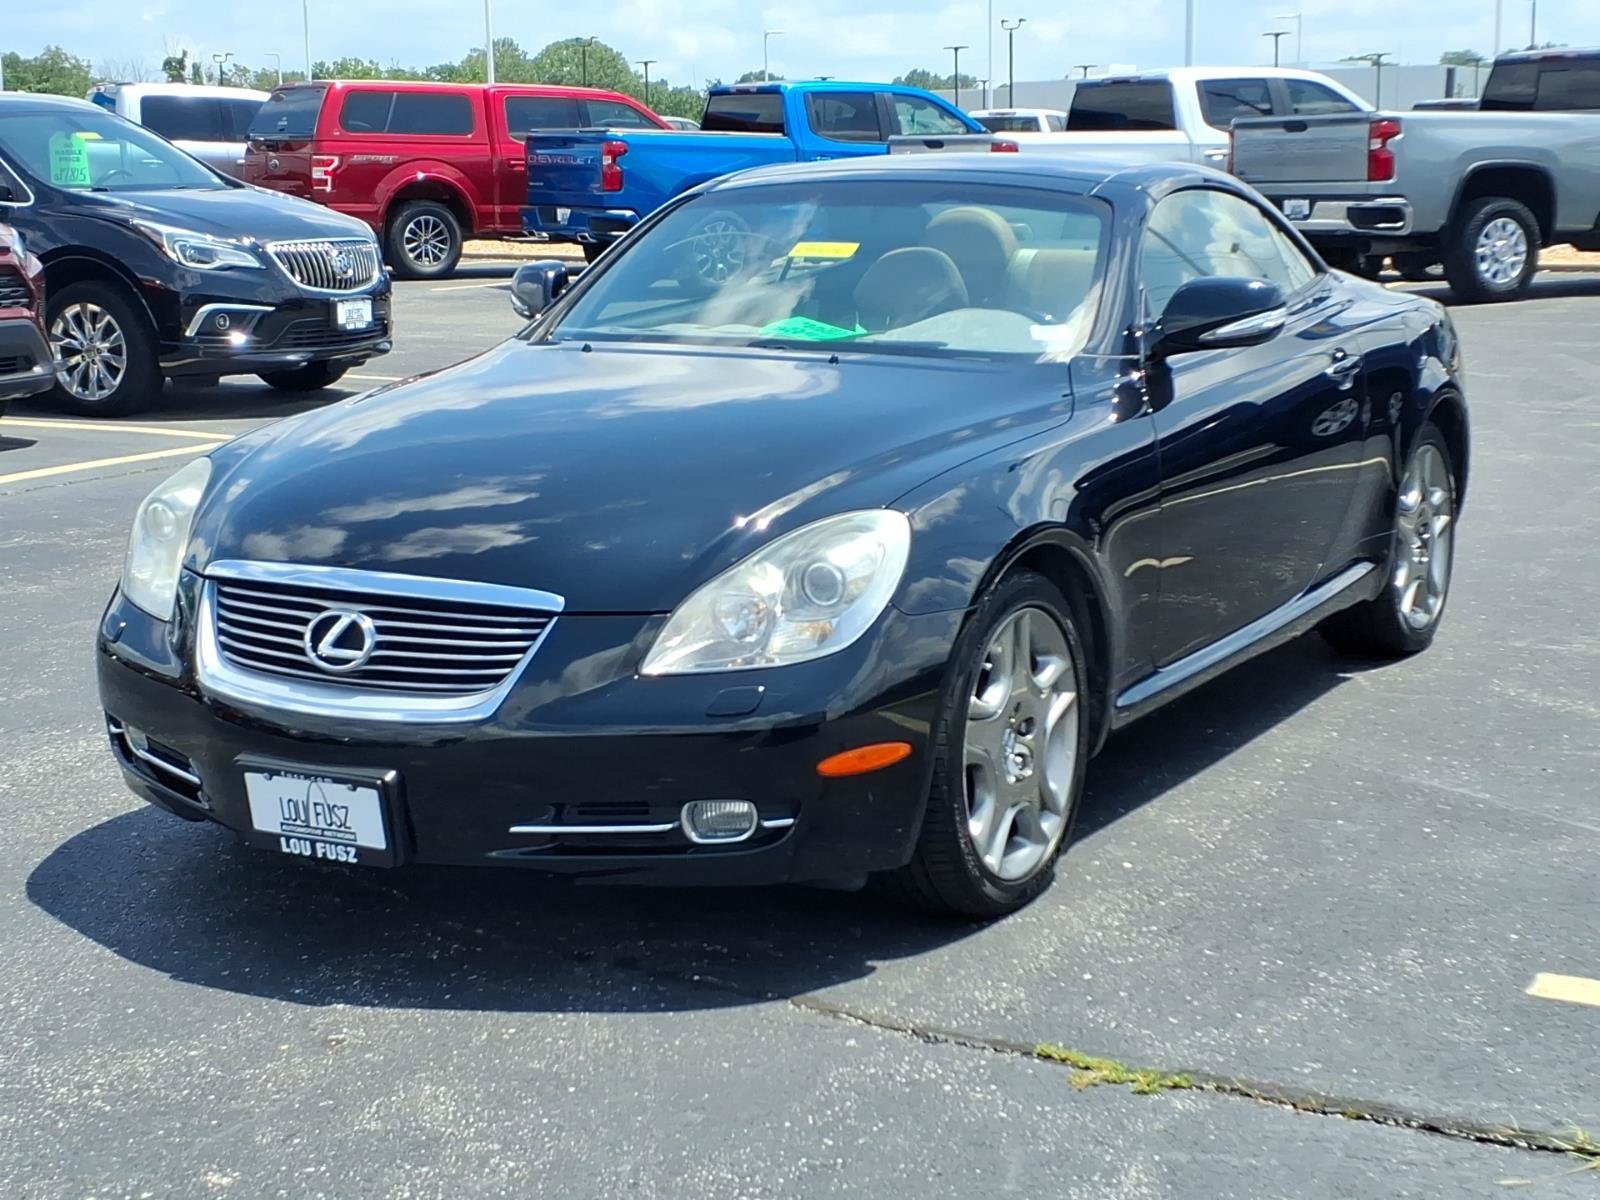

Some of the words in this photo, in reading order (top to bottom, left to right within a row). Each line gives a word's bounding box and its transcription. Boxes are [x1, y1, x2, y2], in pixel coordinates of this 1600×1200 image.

[279, 796, 309, 824] LOU
[313, 802, 352, 830] FUSZ
[280, 836, 312, 857] LOU
[315, 842, 358, 864] FUSZ
